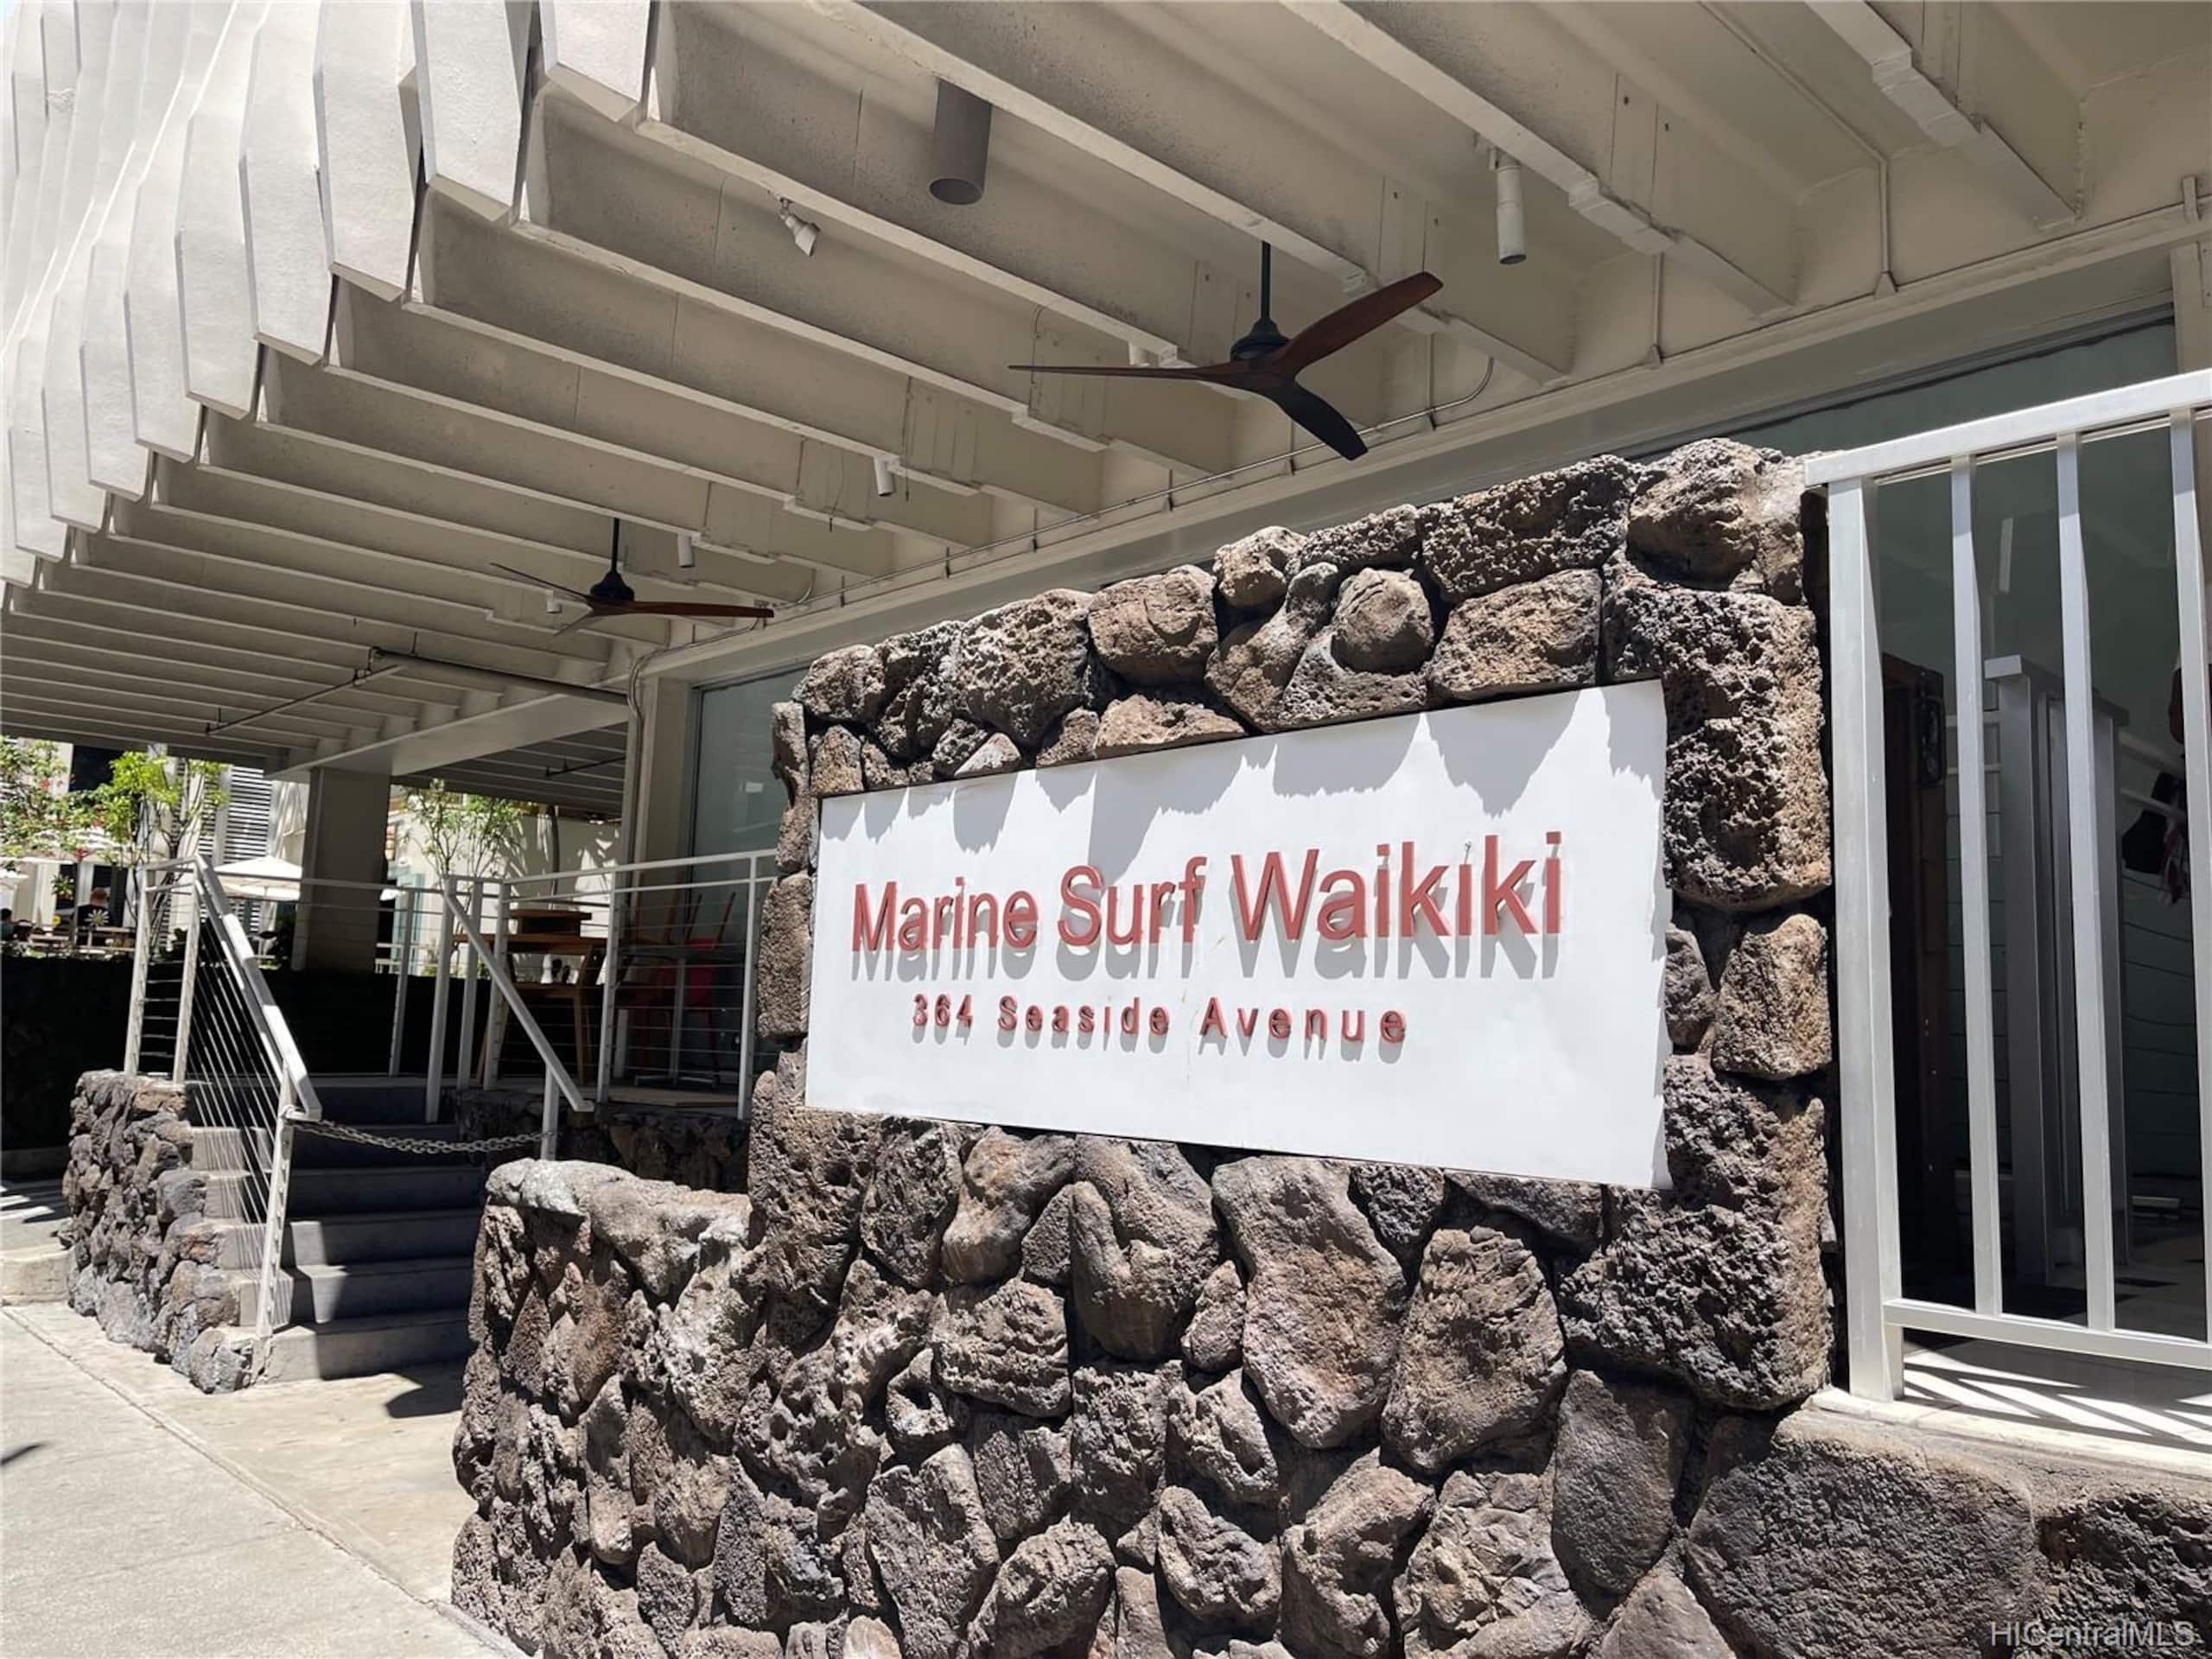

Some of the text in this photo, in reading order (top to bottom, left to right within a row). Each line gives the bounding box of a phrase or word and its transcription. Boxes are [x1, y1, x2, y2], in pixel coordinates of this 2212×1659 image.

[851, 830, 1562, 952] Marine Surf Waikiki
[912, 993, 1407, 1044] 364 Seaside Avenue
